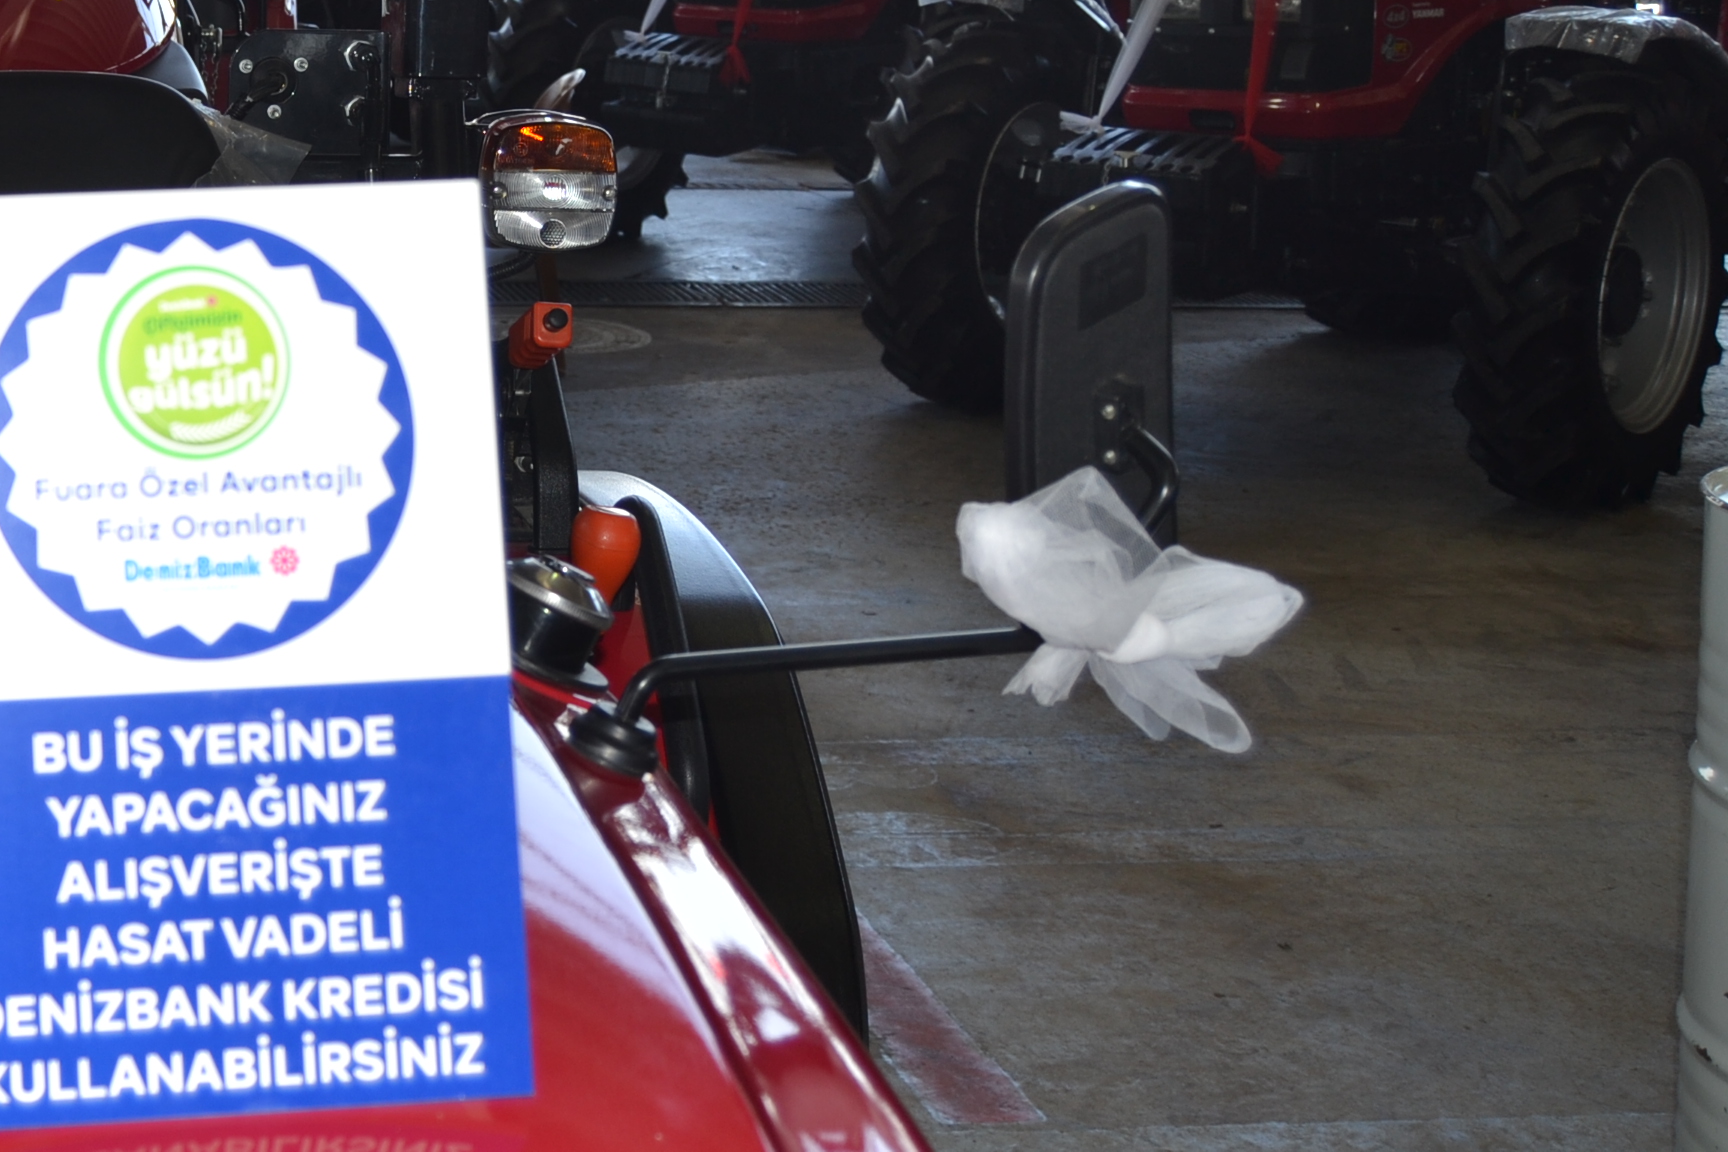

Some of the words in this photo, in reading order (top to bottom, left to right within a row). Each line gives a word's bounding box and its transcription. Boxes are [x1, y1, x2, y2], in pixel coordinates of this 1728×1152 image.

[144, 330, 248, 382] yüzü
[35, 478, 129, 502] Fuara
[140, 467, 210, 498] Özel
[220, 463, 365, 498] Avantajlı
[96, 518, 161, 542] Faiz
[172, 514, 307, 540] Oranları
[124, 555, 263, 583] DenizBank
[32, 730, 102, 775] BU
[114, 716, 162, 778] İŞ
[169, 709, 396, 767] YERİNDE
[45, 775, 388, 838] YAPACAĞINIZ
[56, 839, 384, 908] ALIŞVERİŞTE
[43, 919, 213, 970] HASAT
[220, 897, 405, 958] VADELİ
[283, 955, 484, 1021] KREDİSİ
